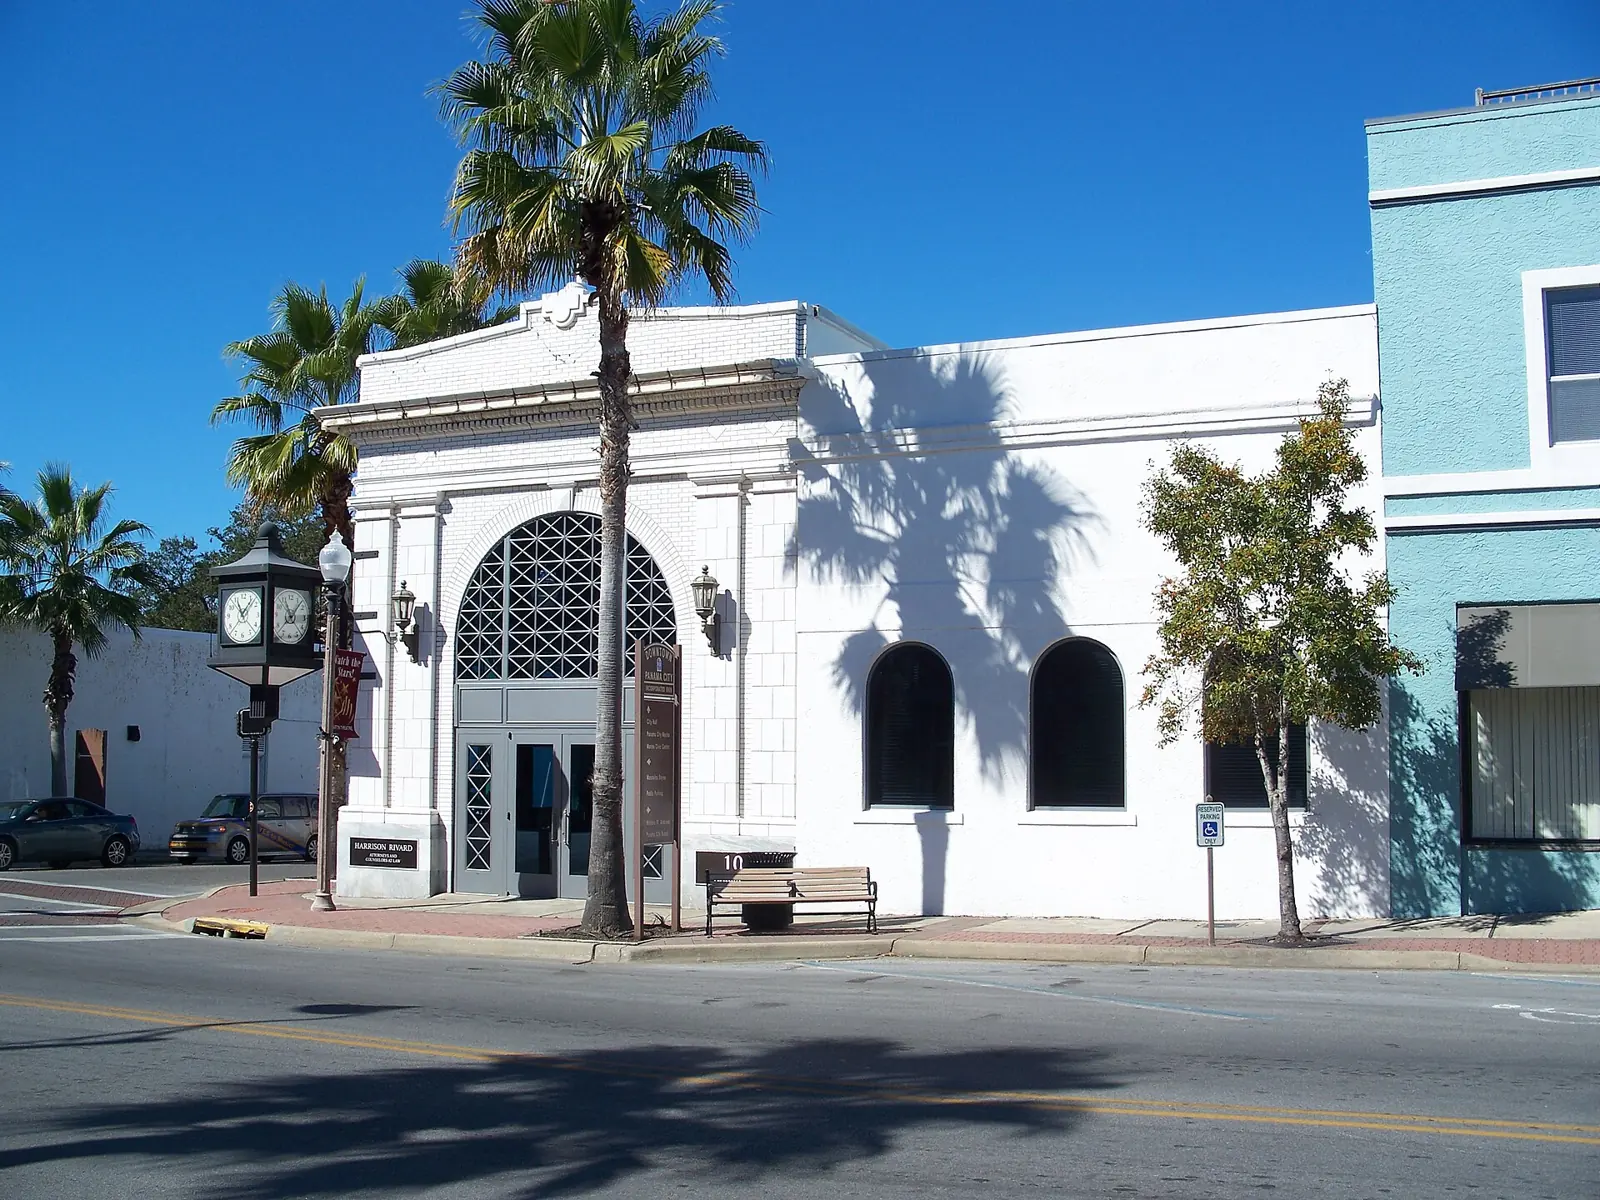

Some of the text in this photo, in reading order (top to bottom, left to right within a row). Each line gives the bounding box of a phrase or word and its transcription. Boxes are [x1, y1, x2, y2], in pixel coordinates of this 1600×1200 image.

[645, 647, 673, 663] DOWNTOWN
[351, 657, 361, 667] the
[644, 670, 673, 683] PANAMA CITY
[354, 842, 414, 852] HARRISON RIVARD
